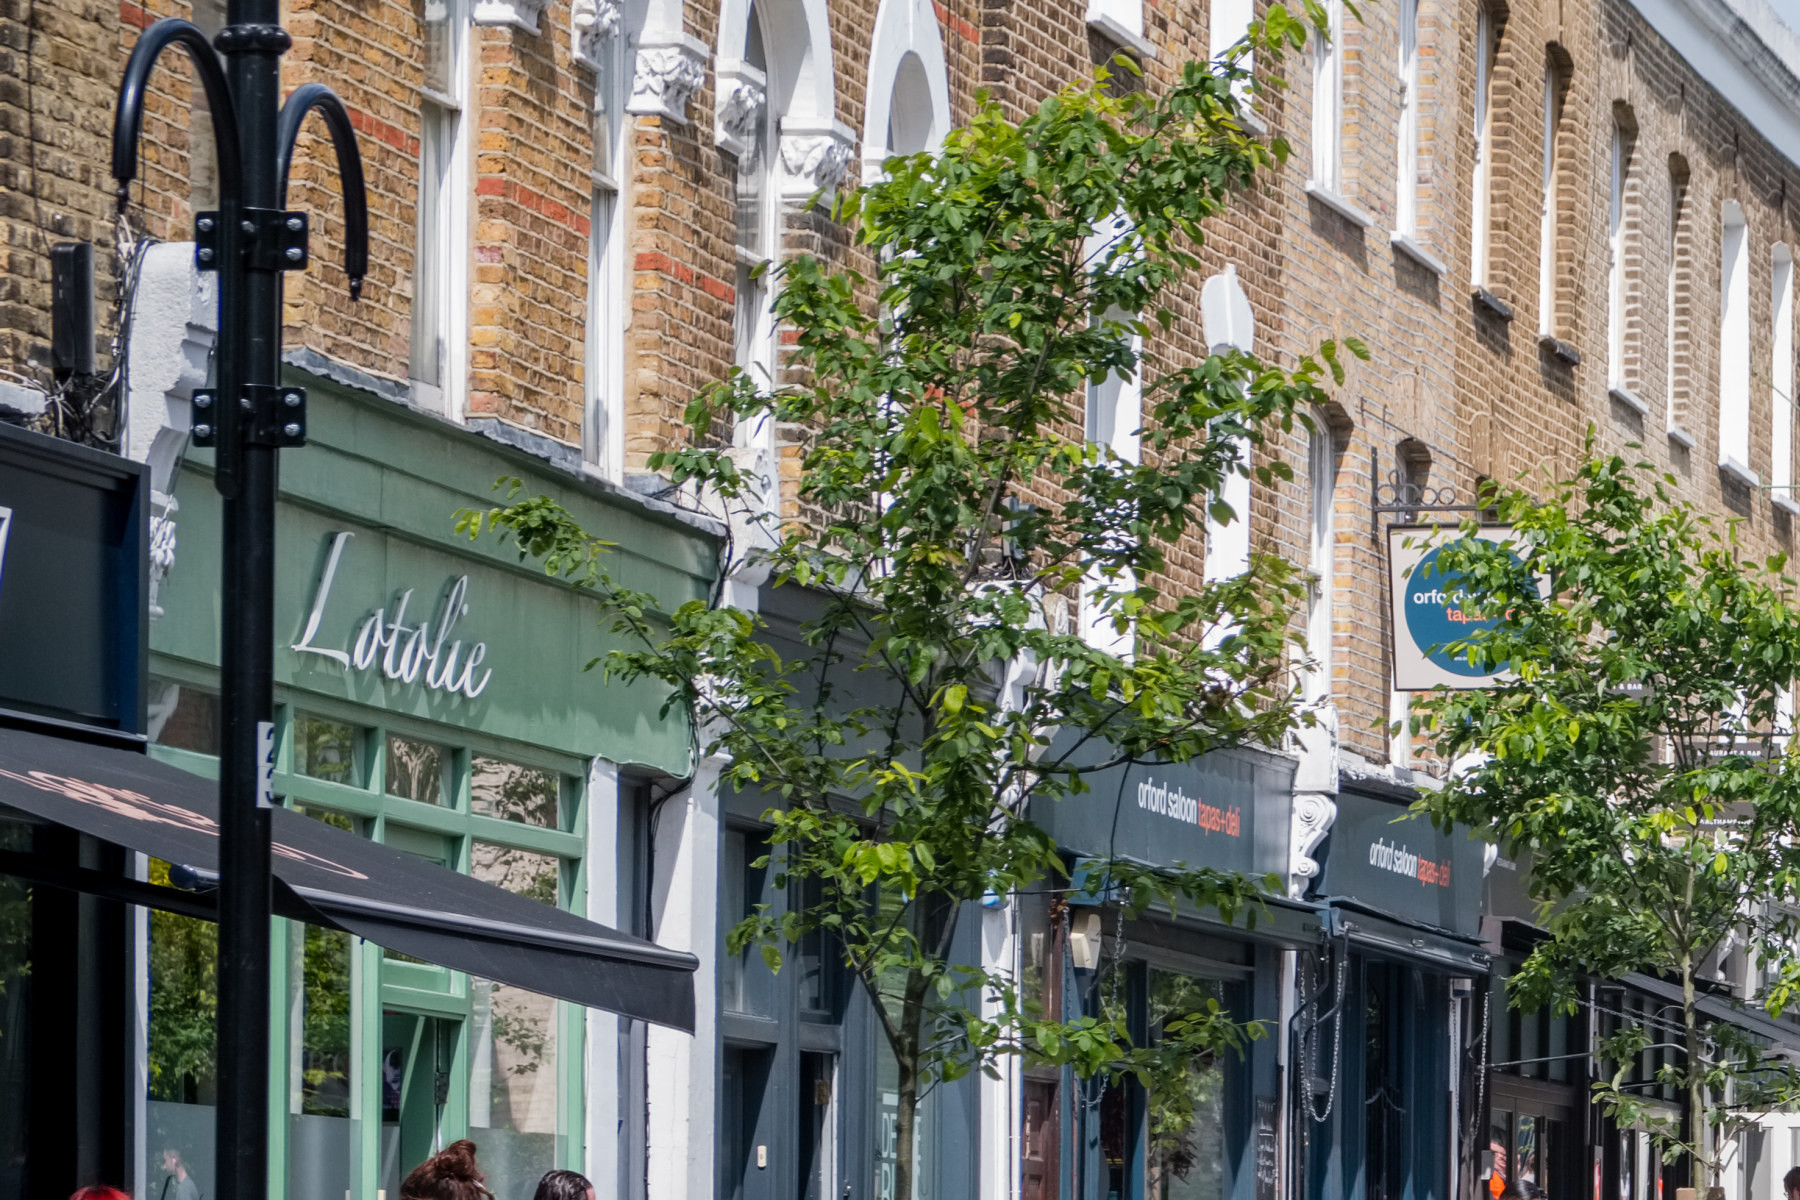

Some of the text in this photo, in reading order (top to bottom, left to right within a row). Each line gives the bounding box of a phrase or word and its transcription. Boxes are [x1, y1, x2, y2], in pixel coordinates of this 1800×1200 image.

[1138, 777, 1167, 815] orford
[1167, 786, 1197, 825] saloon
[1369, 837, 1394, 871] orford
[1393, 844, 1418, 878] saloon
